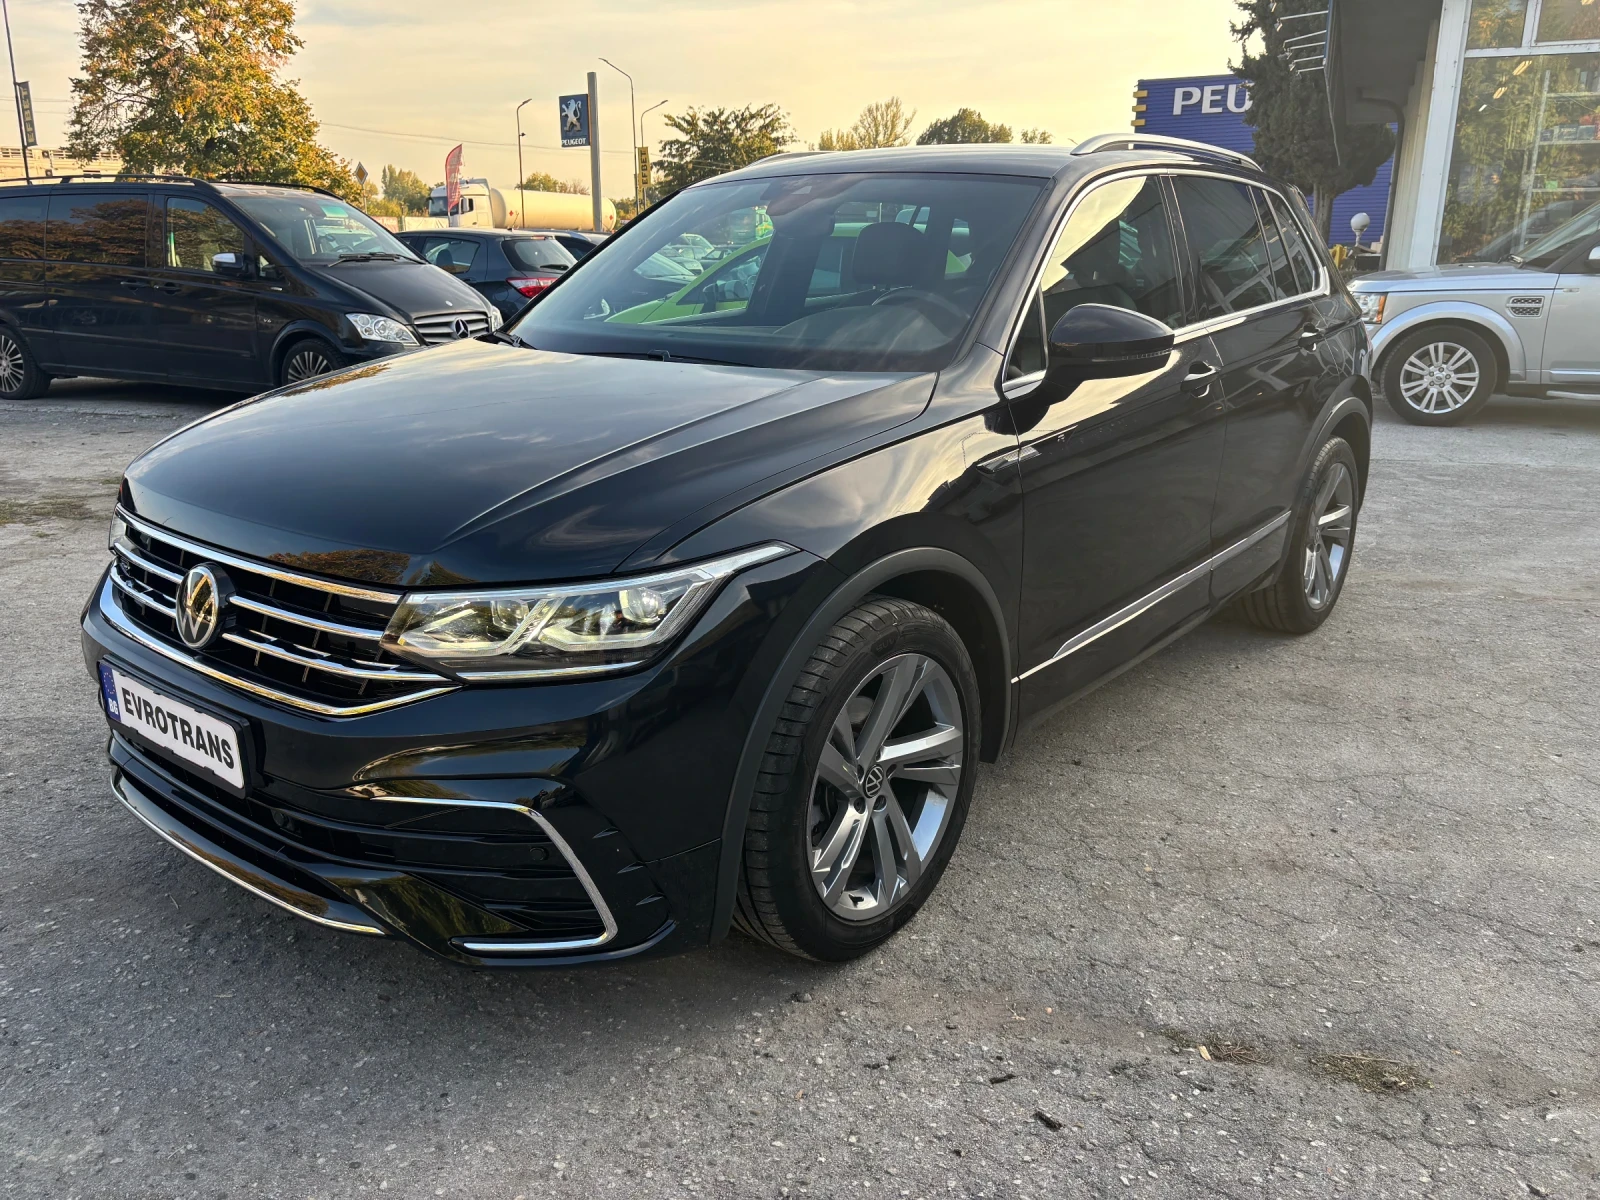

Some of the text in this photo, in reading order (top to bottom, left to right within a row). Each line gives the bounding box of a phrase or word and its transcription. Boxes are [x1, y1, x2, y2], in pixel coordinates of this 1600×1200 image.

[561, 137, 587, 146] PEUGEOT
[640, 150, 649, 185] EFBET
[108, 697, 119, 715] BG
[121, 687, 235, 770] EVROTRANS
